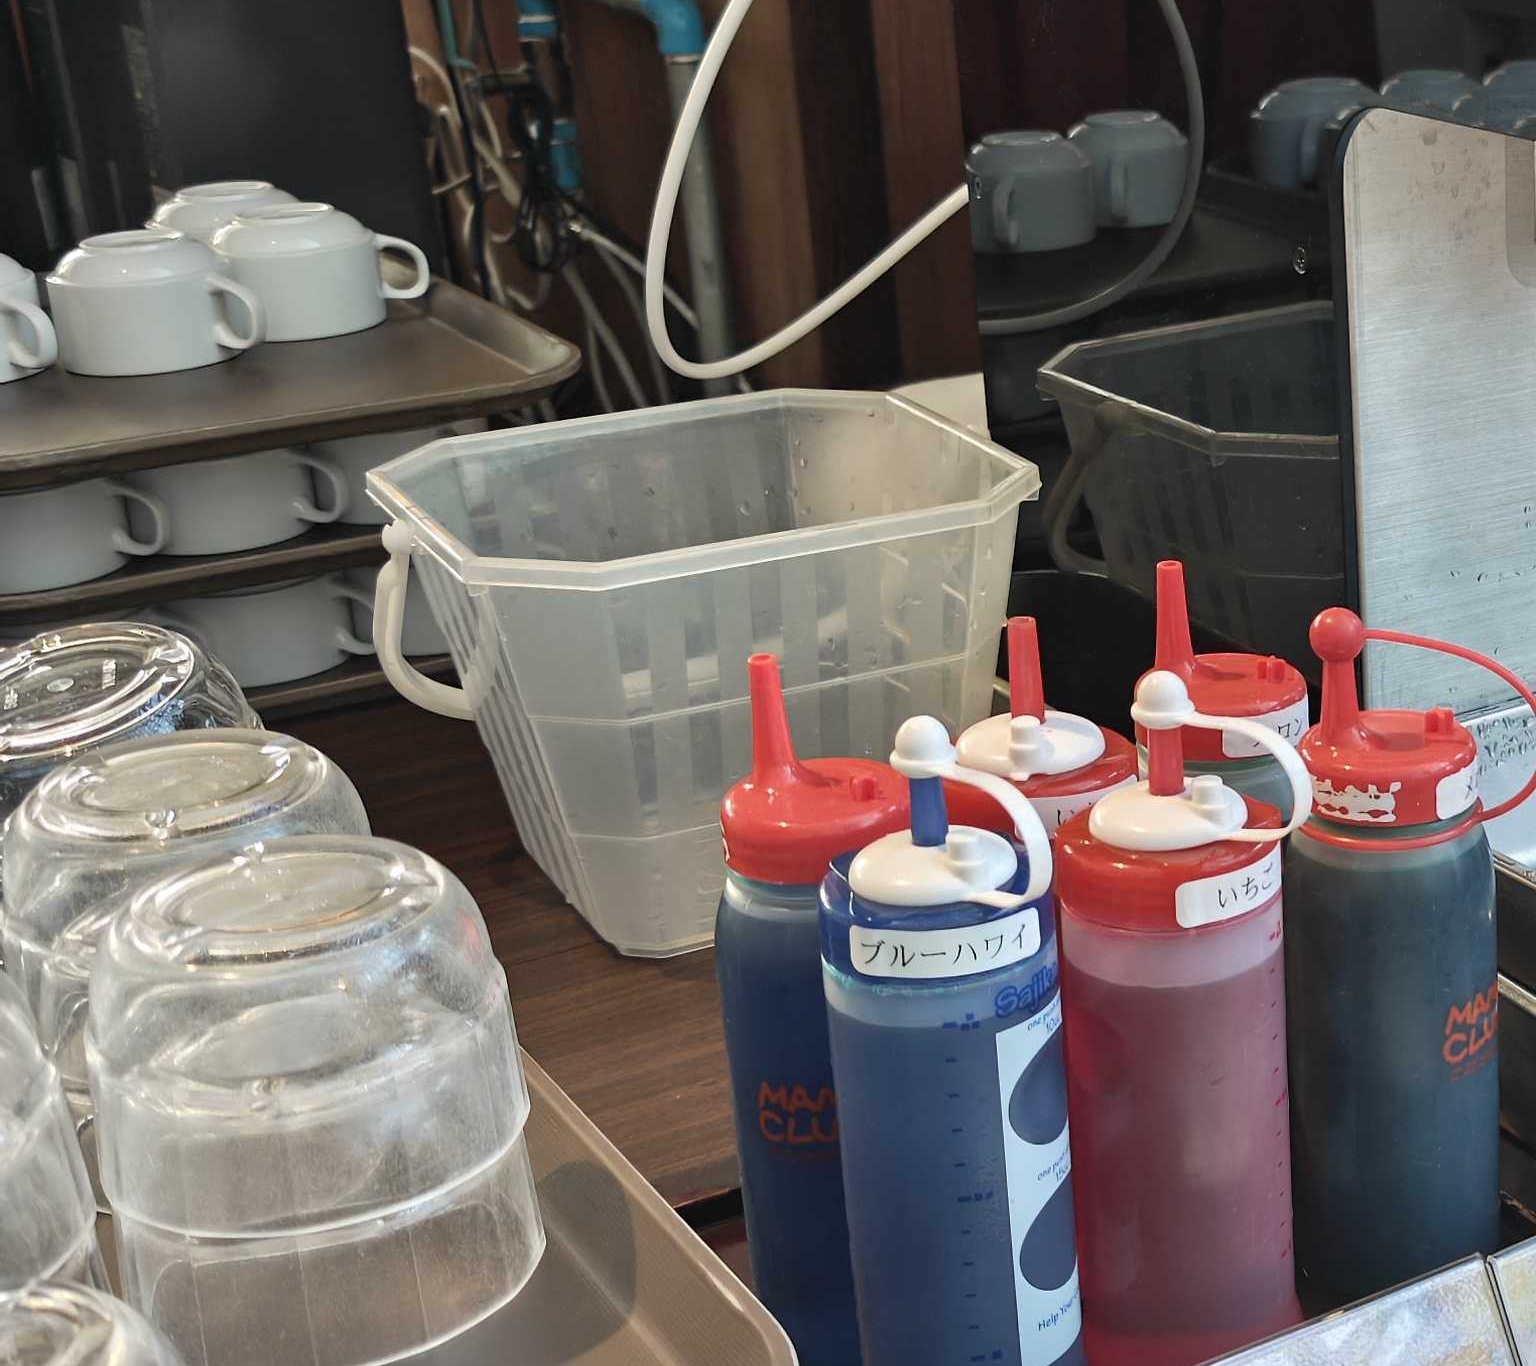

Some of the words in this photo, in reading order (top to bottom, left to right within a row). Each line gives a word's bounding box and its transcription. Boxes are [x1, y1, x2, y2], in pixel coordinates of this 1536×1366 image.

[1217, 862, 1273, 908] いちご
[861, 923, 1026, 968] ブルーハワイ
